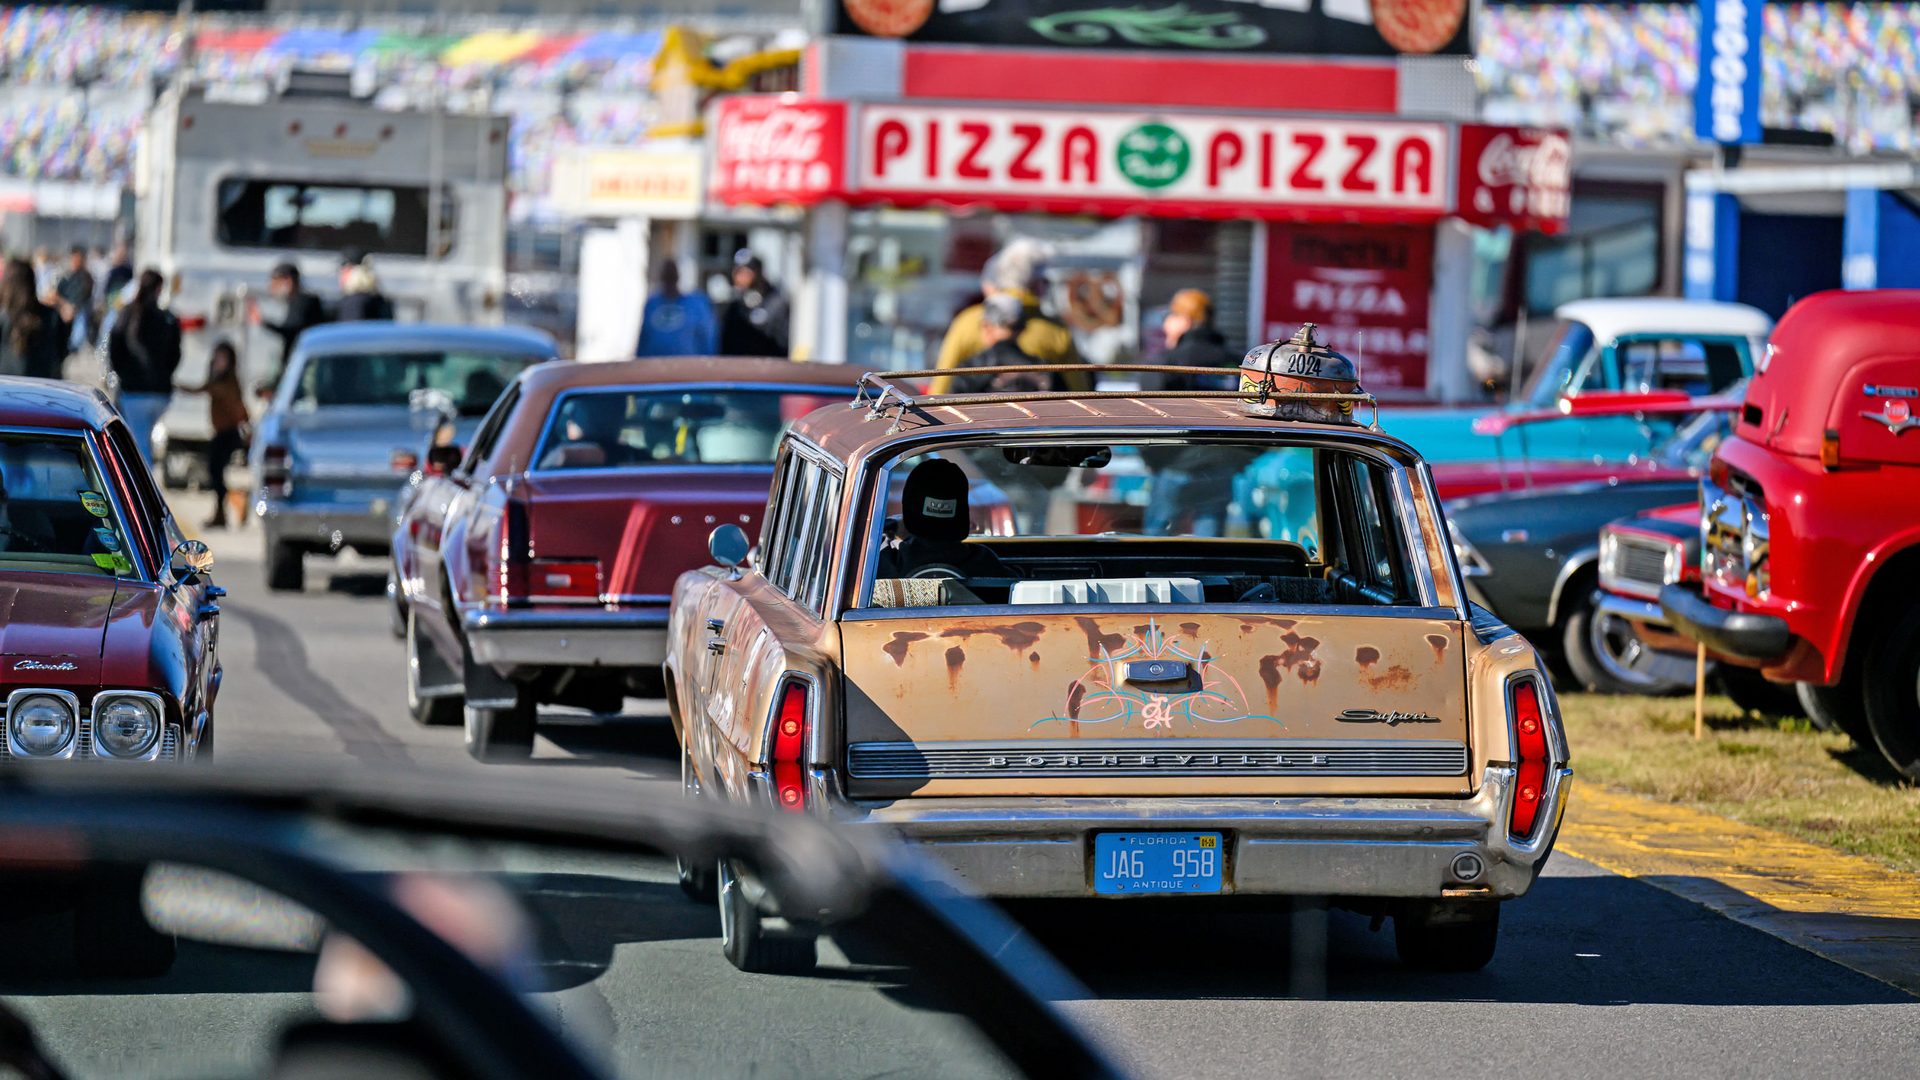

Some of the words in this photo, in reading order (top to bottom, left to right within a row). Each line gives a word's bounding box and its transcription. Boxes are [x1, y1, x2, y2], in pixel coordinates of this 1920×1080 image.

[874, 119, 1097, 184] PIZZA
[1207, 130, 1432, 194] PIZZA
[1293, 280, 1407, 315] PIZZA
[1287, 353, 1322, 376] 2024
[1334, 708, 1441, 727] Safari
[988, 754, 1330, 768] BONNEVILLE
[1130, 837, 1187, 845] FLORIDA
[1103, 850, 1144, 879] JA6
[1172, 849, 1214, 878] 958
[1132, 880, 1184, 889] ANTIQUE
